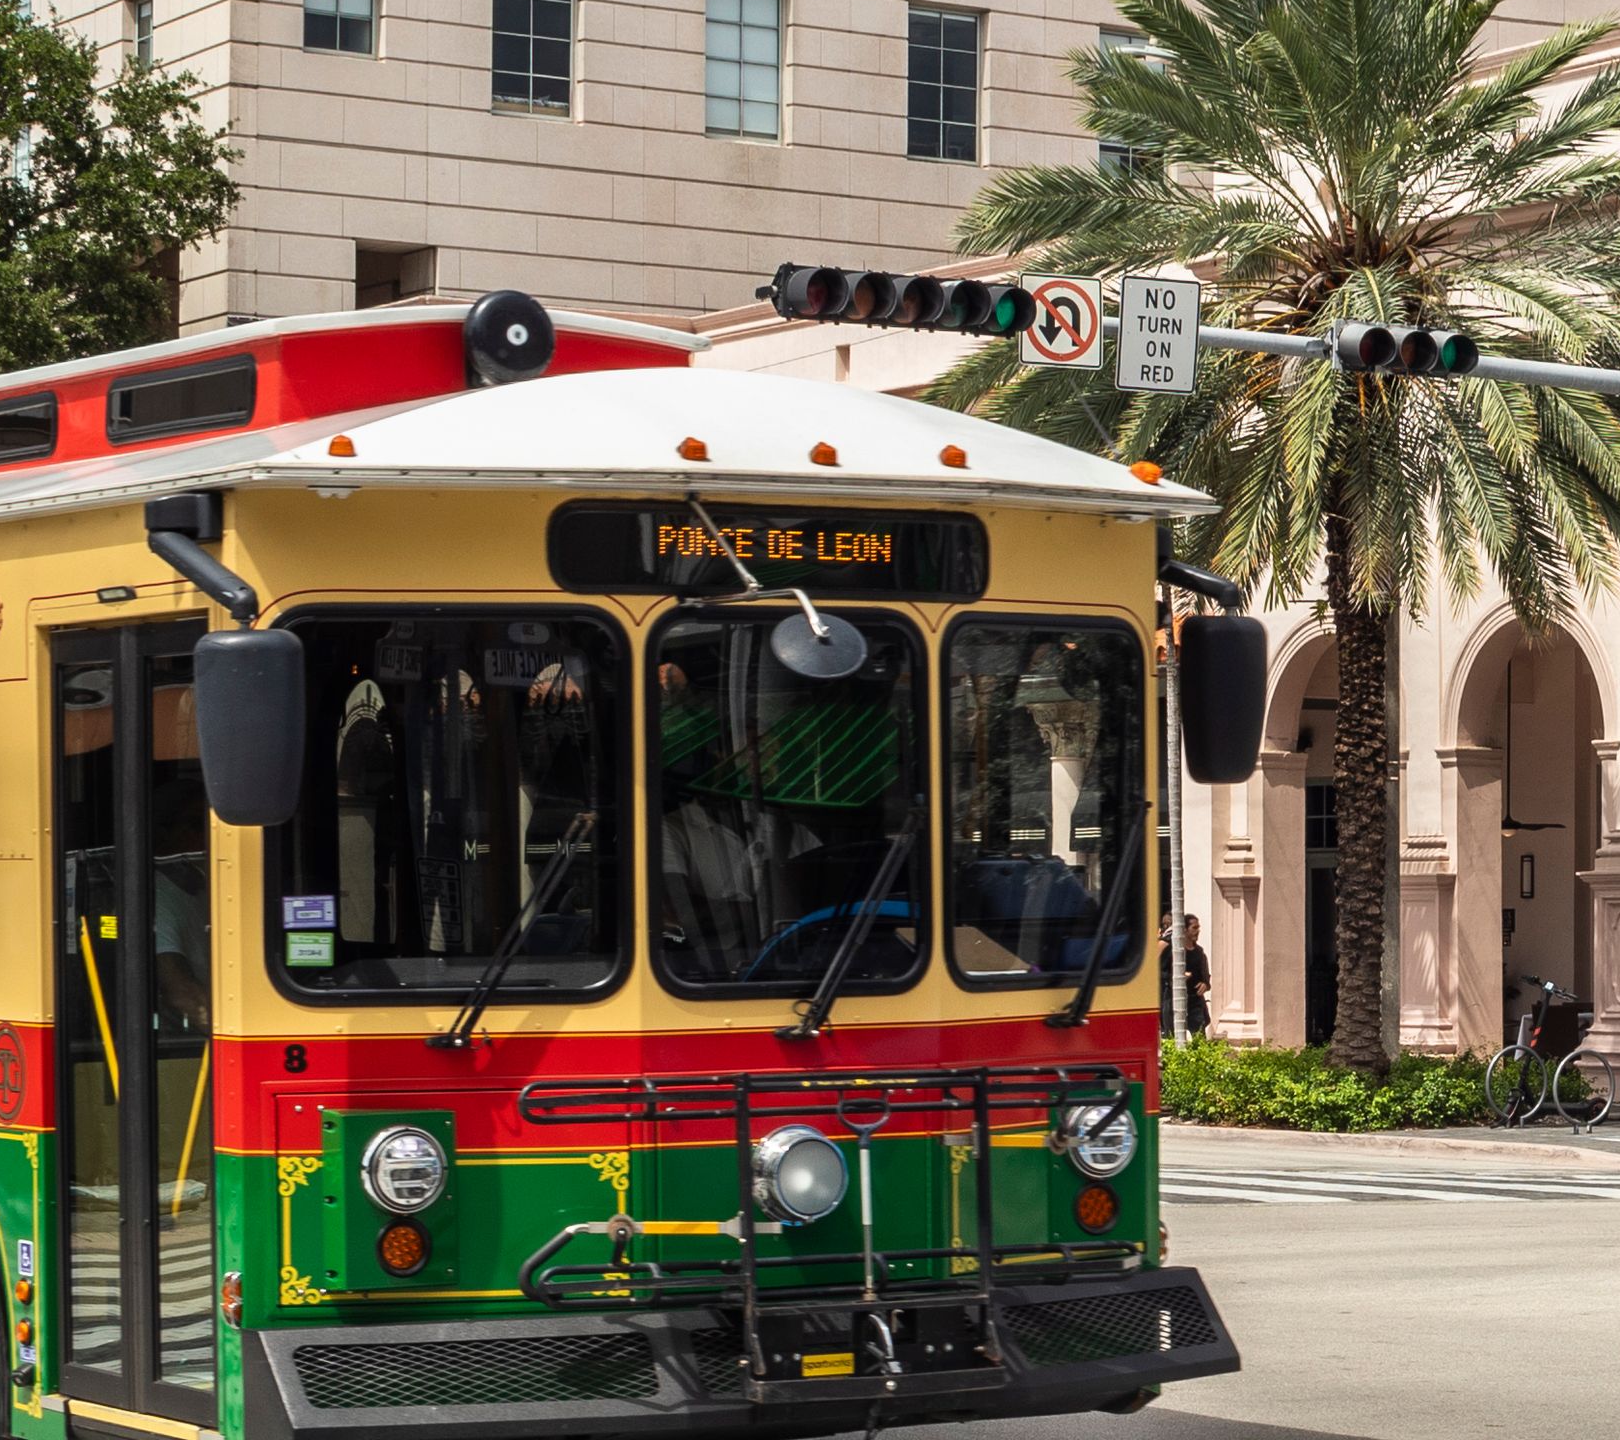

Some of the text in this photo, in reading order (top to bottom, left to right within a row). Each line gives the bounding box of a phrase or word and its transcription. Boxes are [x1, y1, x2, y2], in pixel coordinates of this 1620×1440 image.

[1145, 287, 1176, 310] NO
[1137, 315, 1182, 335] TURN
[1146, 340, 1171, 359] ON
[1140, 364, 1174, 383] RED
[658, 525, 892, 562] PONCE DE LEON
[284, 1044, 308, 1074] 8
